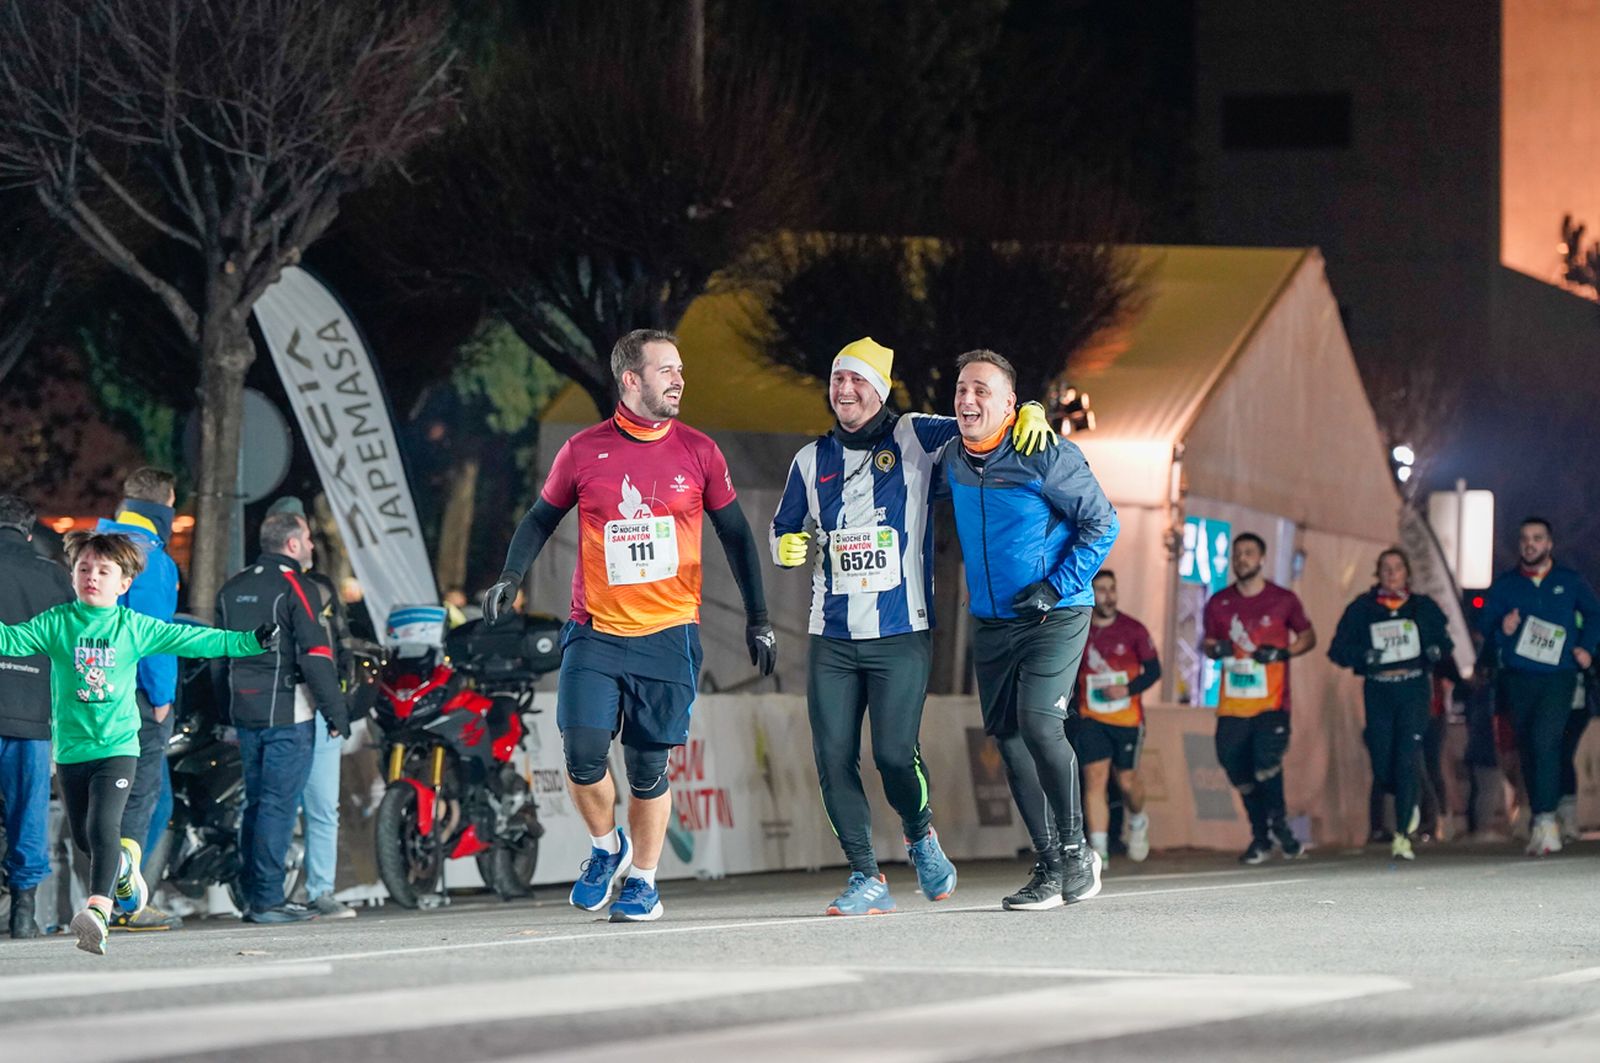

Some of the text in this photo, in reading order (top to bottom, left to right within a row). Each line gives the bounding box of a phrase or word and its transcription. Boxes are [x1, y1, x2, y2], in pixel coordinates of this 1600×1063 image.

[317, 318, 413, 539] JAPEMASA
[620, 525, 640, 533] NOCHE
[612, 535, 626, 543] SAN
[628, 542, 654, 561] 111
[836, 544, 848, 552] SAN
[840, 550, 887, 572] 6526
[80, 637, 109, 648] I'M ON
[74, 646, 116, 668] FIRE
